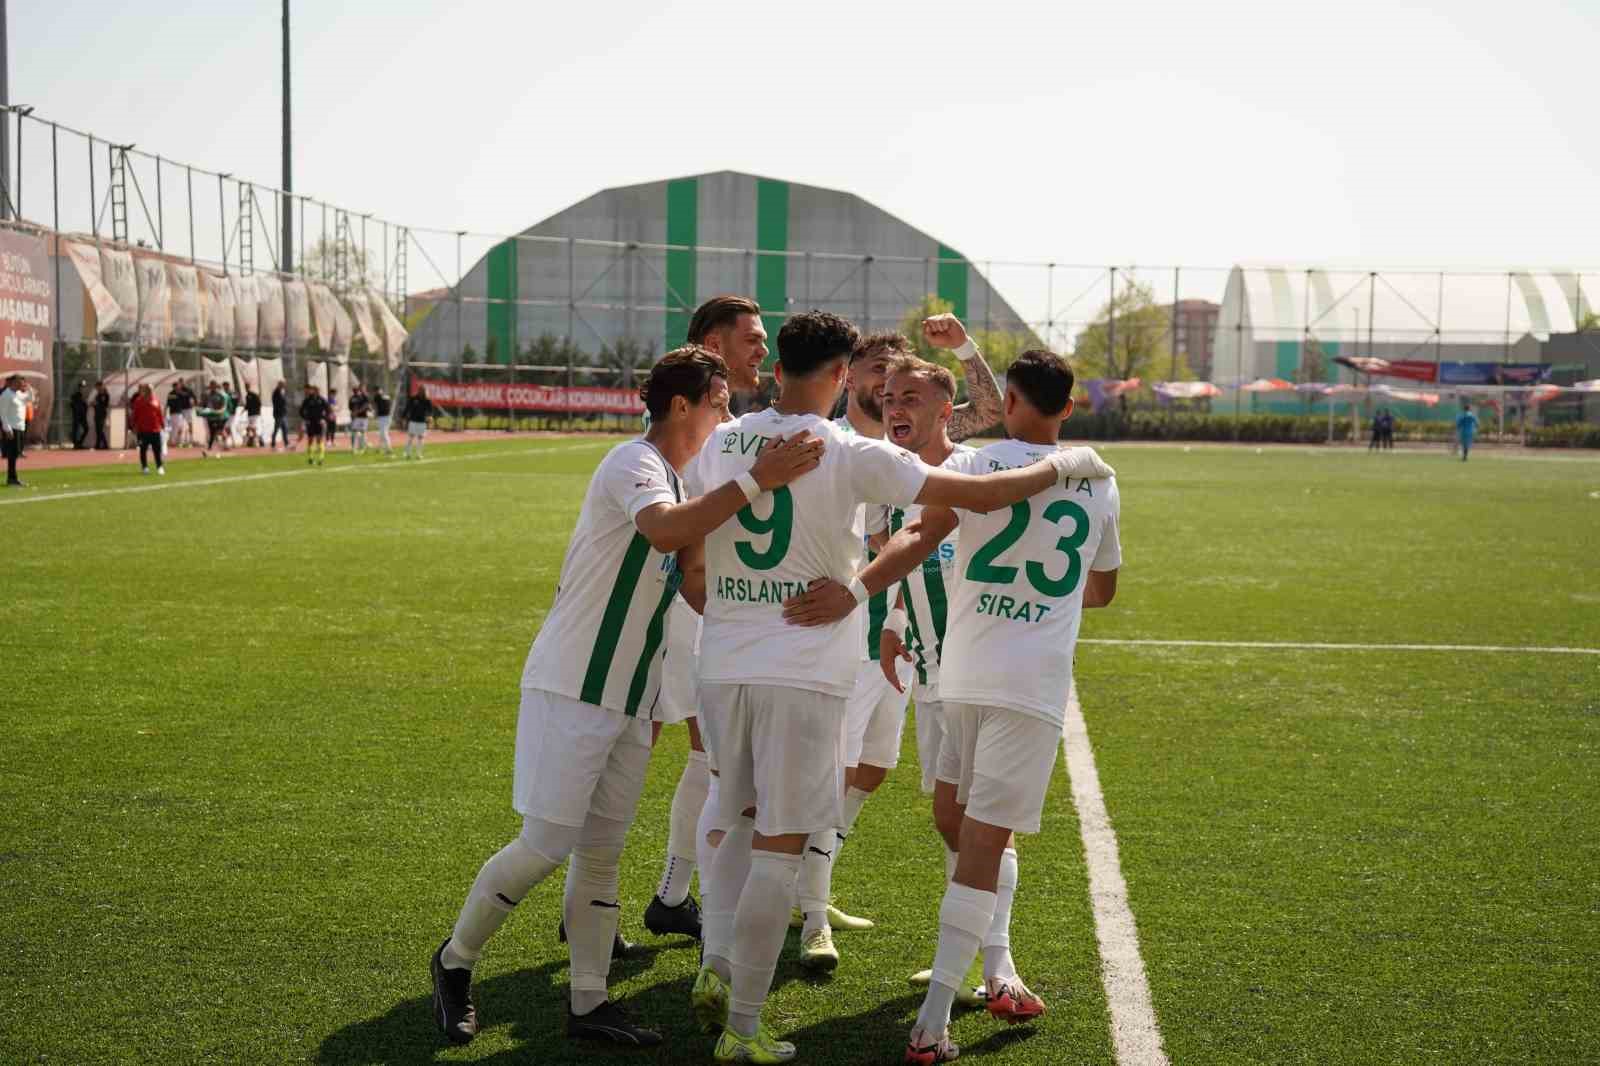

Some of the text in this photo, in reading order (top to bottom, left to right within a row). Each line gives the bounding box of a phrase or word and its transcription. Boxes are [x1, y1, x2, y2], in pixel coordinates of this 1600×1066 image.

[734, 484, 794, 571] 9
[966, 497, 1090, 598] 23
[717, 576, 806, 603] ARSLANTA
[976, 593, 1051, 623] SIRAT
